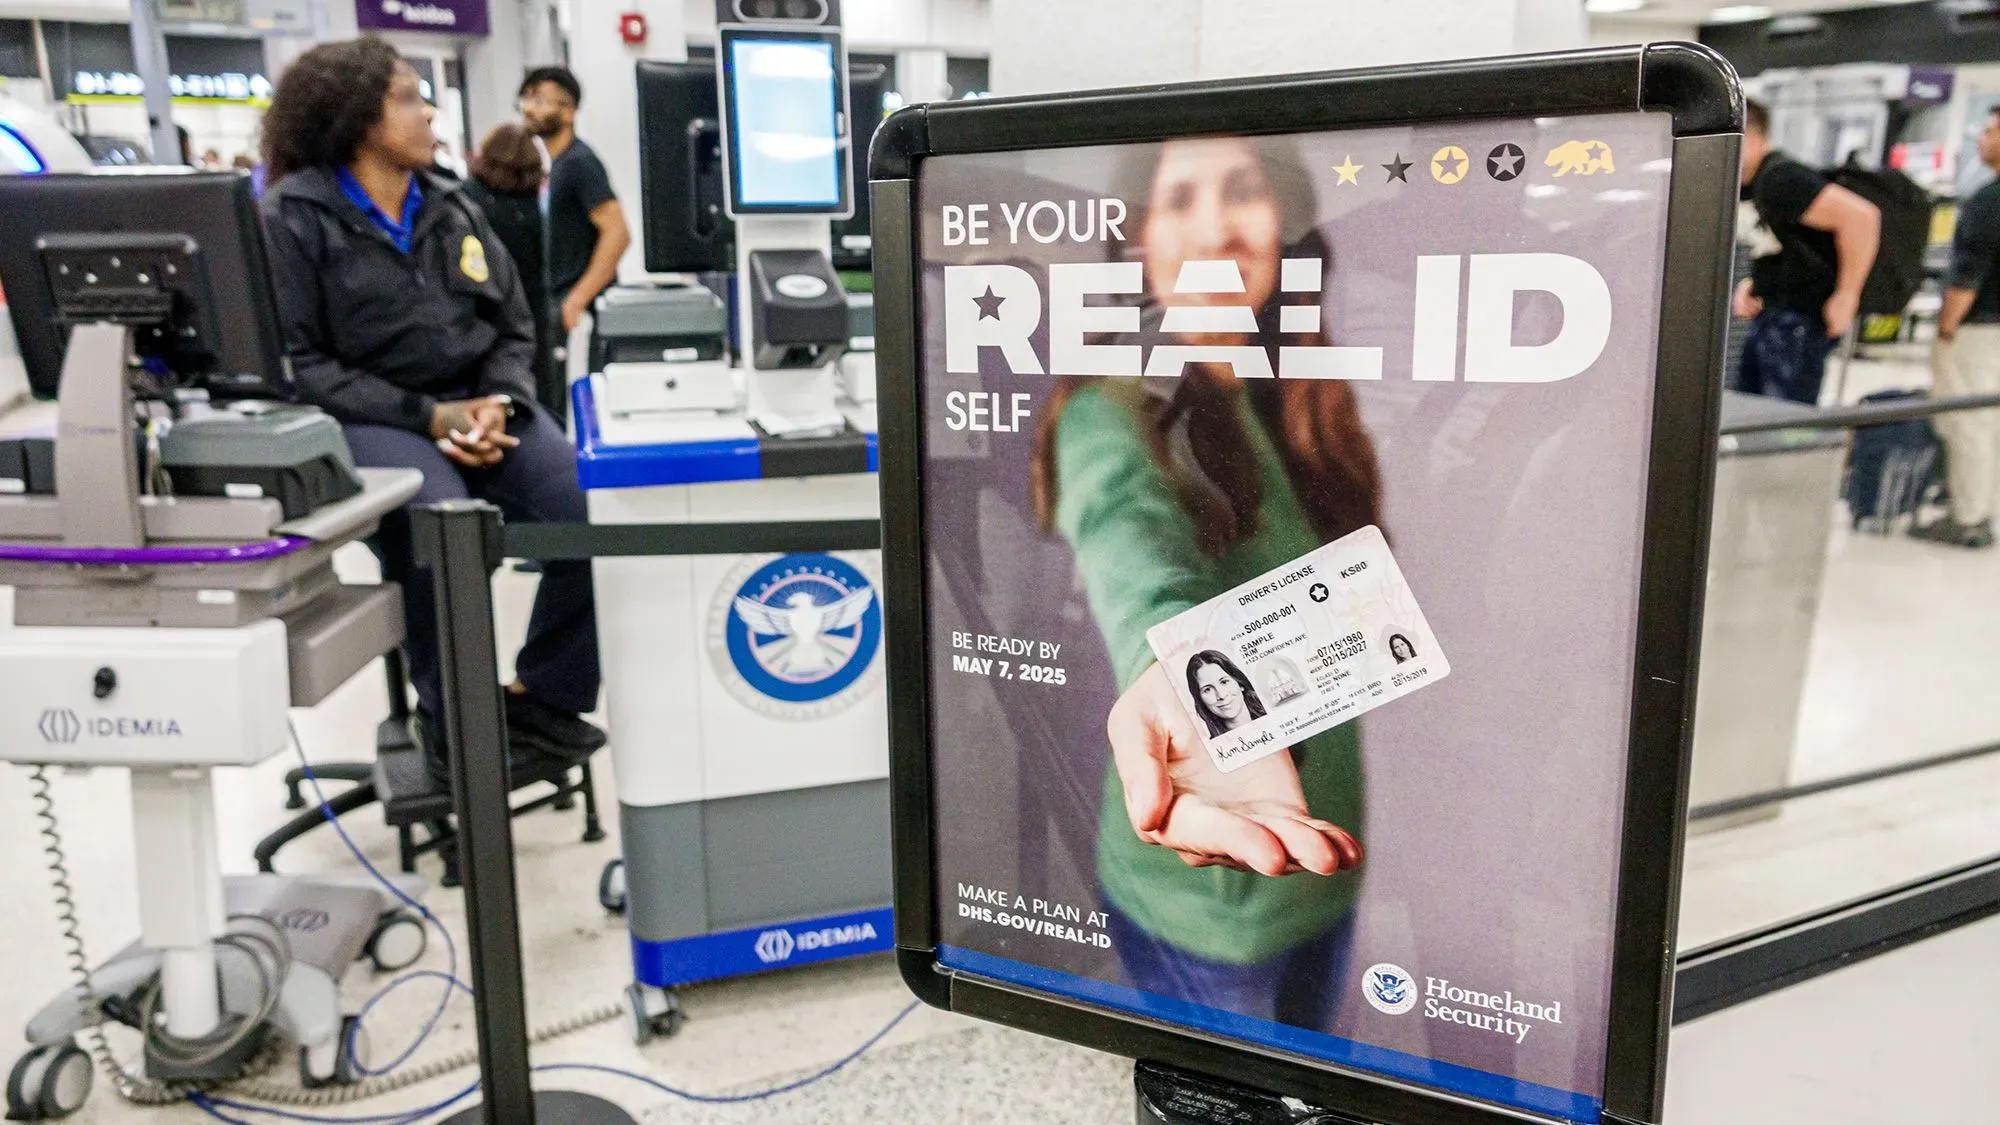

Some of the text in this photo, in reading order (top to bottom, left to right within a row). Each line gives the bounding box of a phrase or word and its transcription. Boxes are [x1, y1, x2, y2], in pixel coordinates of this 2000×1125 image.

[942, 198, 1127, 246] BE YOUR
[944, 252, 1613, 383] REAL ID
[945, 390, 1031, 433] SELF
[1238, 564, 1316, 606] DRIVER'S LICENSE
[1340, 561, 1368, 579] KS80
[1244, 603, 1297, 634] S00-000-001
[952, 631, 1061, 660] BE READY BY
[1241, 632, 1275, 653] SAMPLE
[1260, 640, 1294, 659] CONFIDENT
[1317, 631, 1364, 658] 07/15/1980
[1322, 641, 1368, 668] 02/15/2027
[952, 655, 1067, 686] MAY 7, 2025
[87, 717, 183, 737] IDEMIA
[958, 882, 1110, 928] MAKE A PLAN AT
[796, 922, 878, 951] IDEMIA
[958, 903, 1112, 949] DHS.GOV/REAL-ID
[1425, 976, 1562, 1024] Homeland
[1424, 998, 1532, 1044] Security
